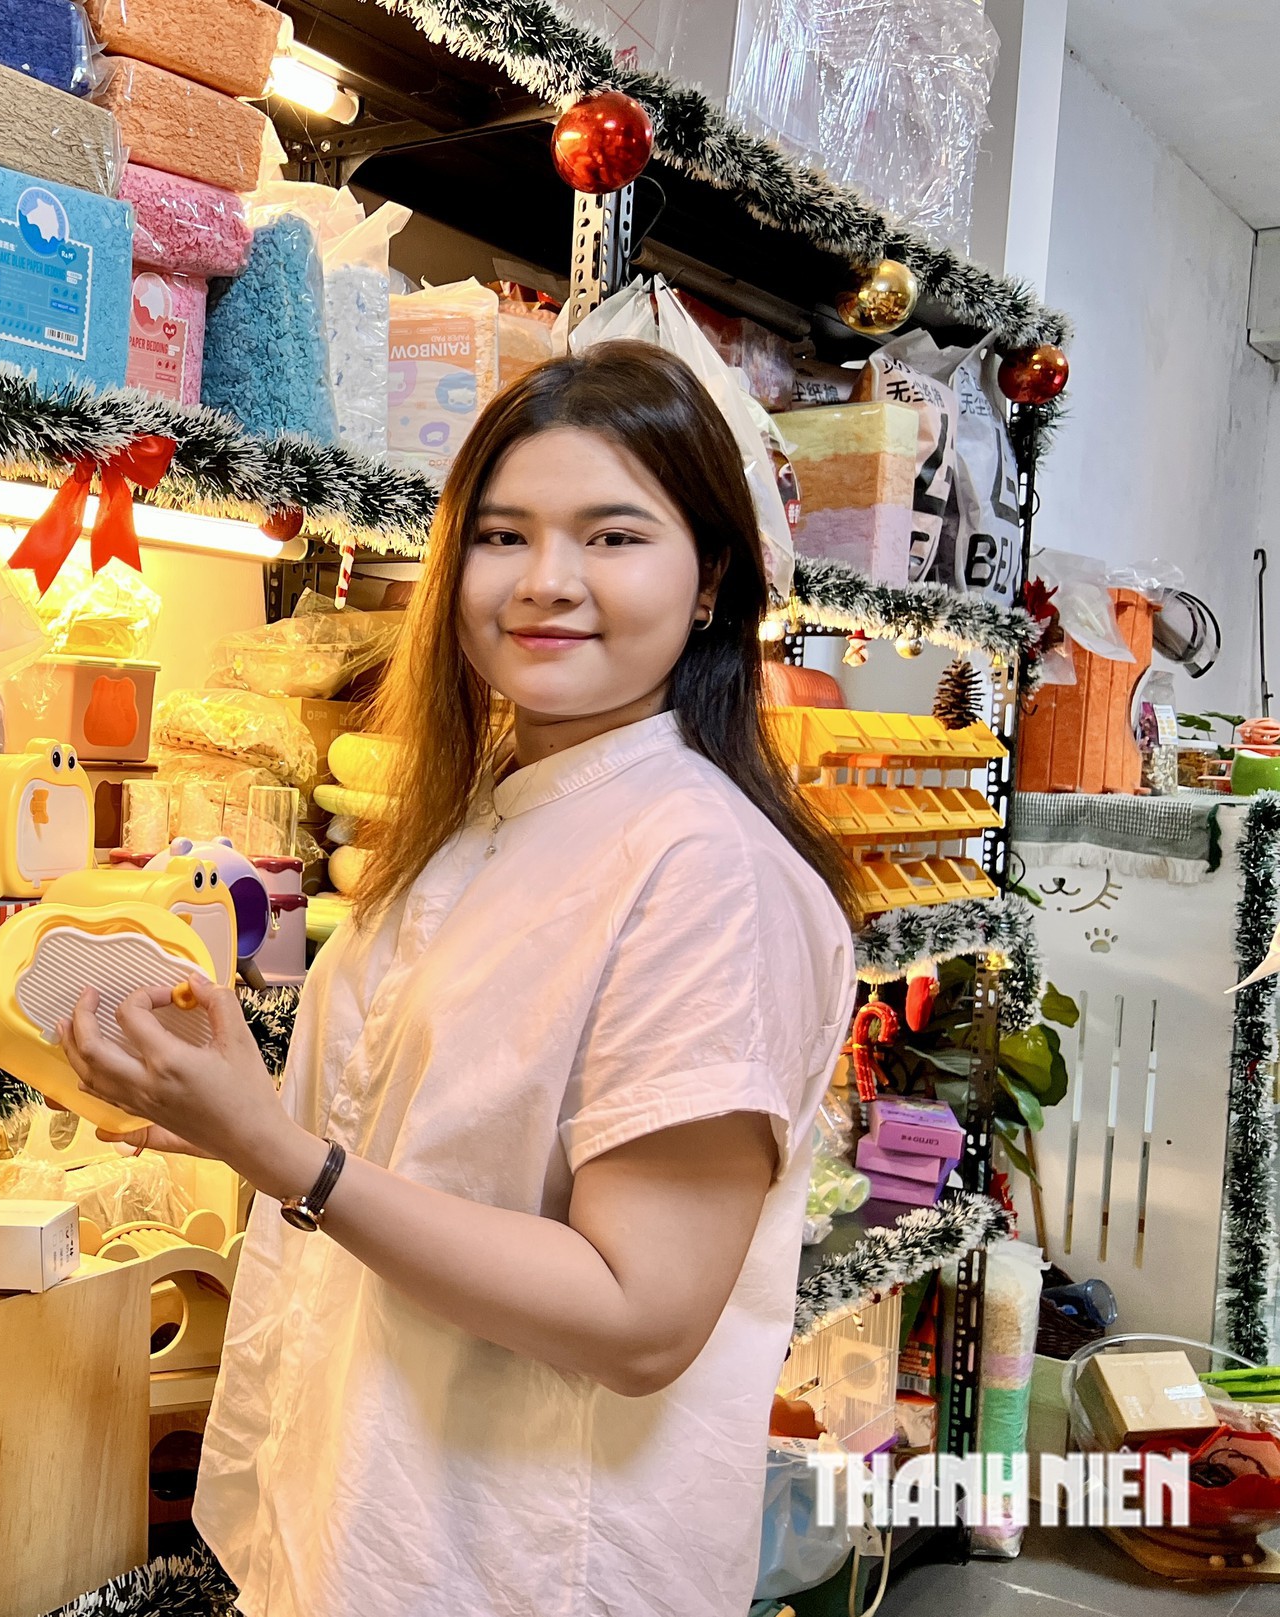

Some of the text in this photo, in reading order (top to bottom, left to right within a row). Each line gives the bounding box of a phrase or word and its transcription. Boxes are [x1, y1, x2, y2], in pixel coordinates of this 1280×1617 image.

[12, 254, 26, 271] BLUE
[27, 258, 43, 275] PAPER
[44, 263, 66, 281] BEDDING
[129, 336, 146, 349] PAPER
[146, 339, 168, 355] BEDDING
[390, 341, 470, 360] RAINBOW
